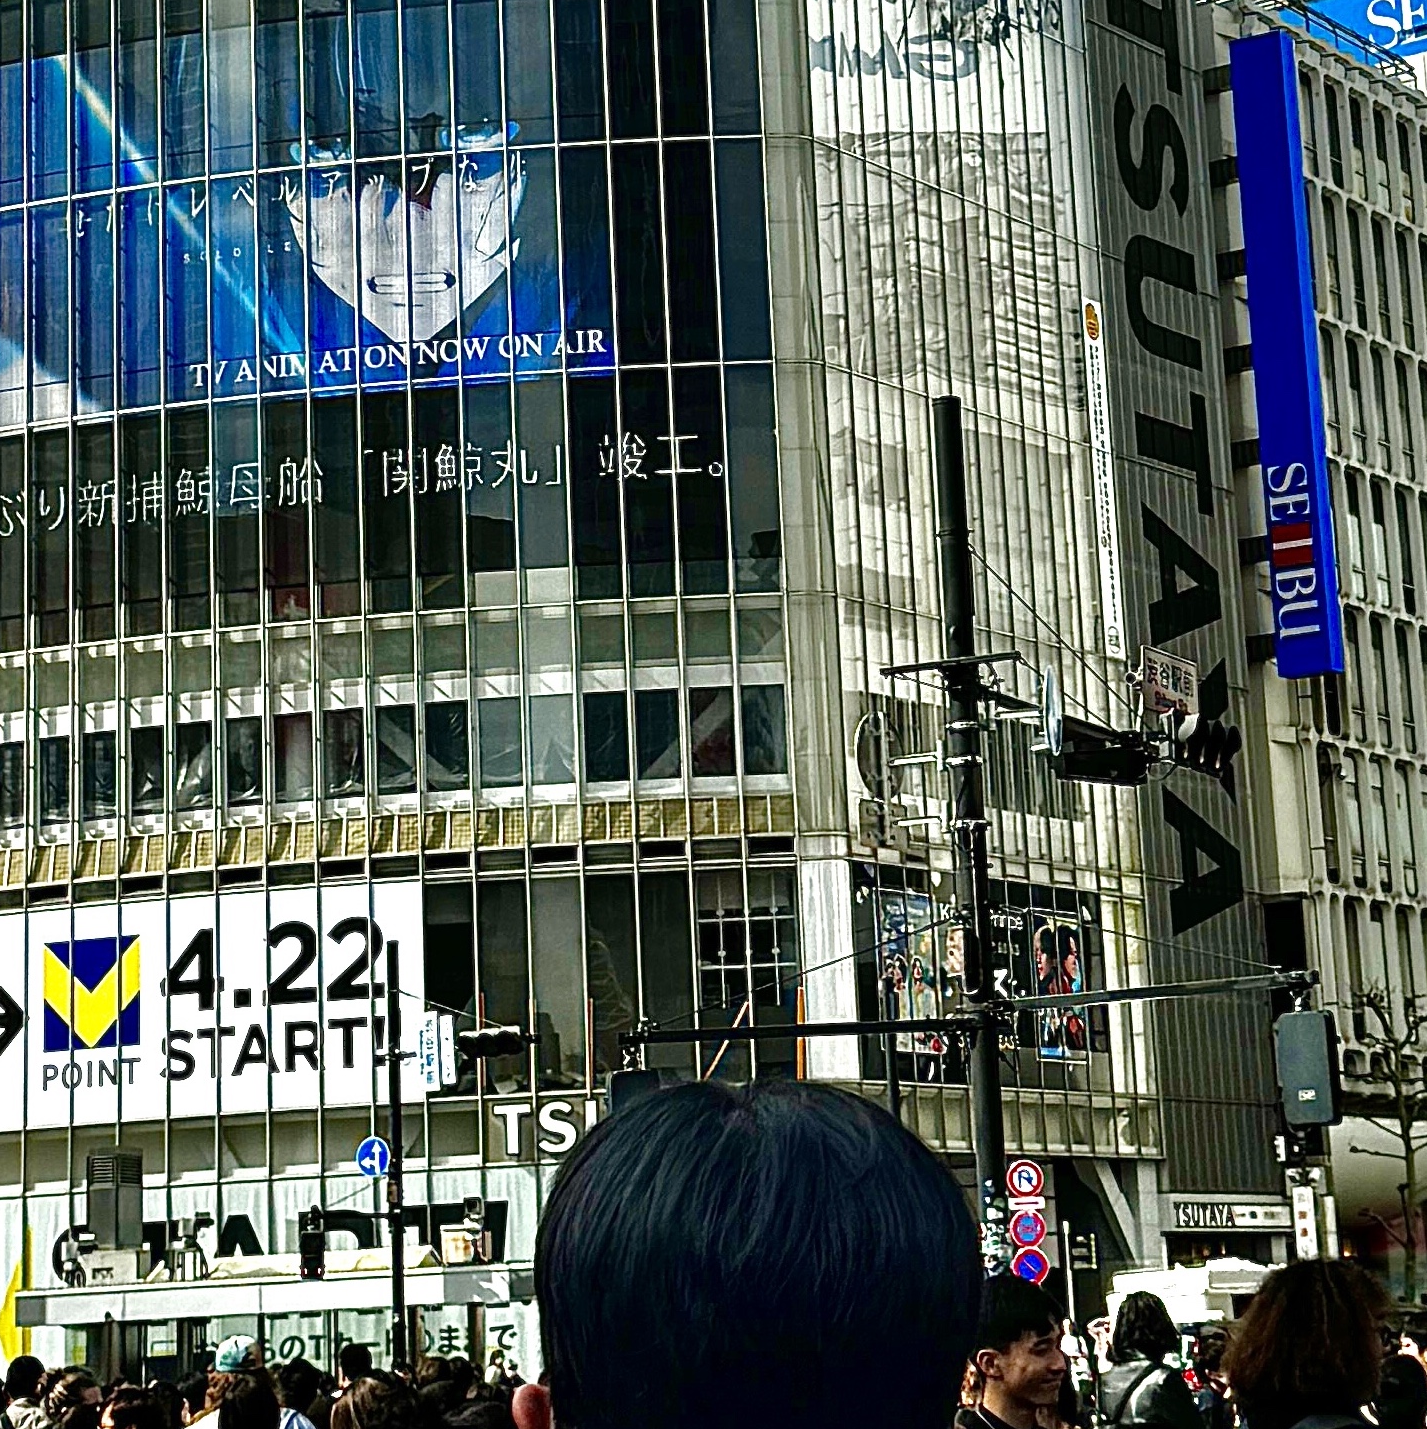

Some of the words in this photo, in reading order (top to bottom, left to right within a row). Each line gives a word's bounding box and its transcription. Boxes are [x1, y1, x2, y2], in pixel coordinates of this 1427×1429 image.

[190, 360, 228, 388] TV
[234, 343, 409, 384] ANIMATON
[416, 335, 489, 365] NOW
[552, 329, 608, 355] AIR
[1265, 463, 1320, 639] SEIBU
[163, 916, 384, 1011] 4.22
[42, 1057, 142, 1092] POINT
[161, 1016, 390, 1082] START!
[1174, 1202, 1236, 1228] TSUTAYA
